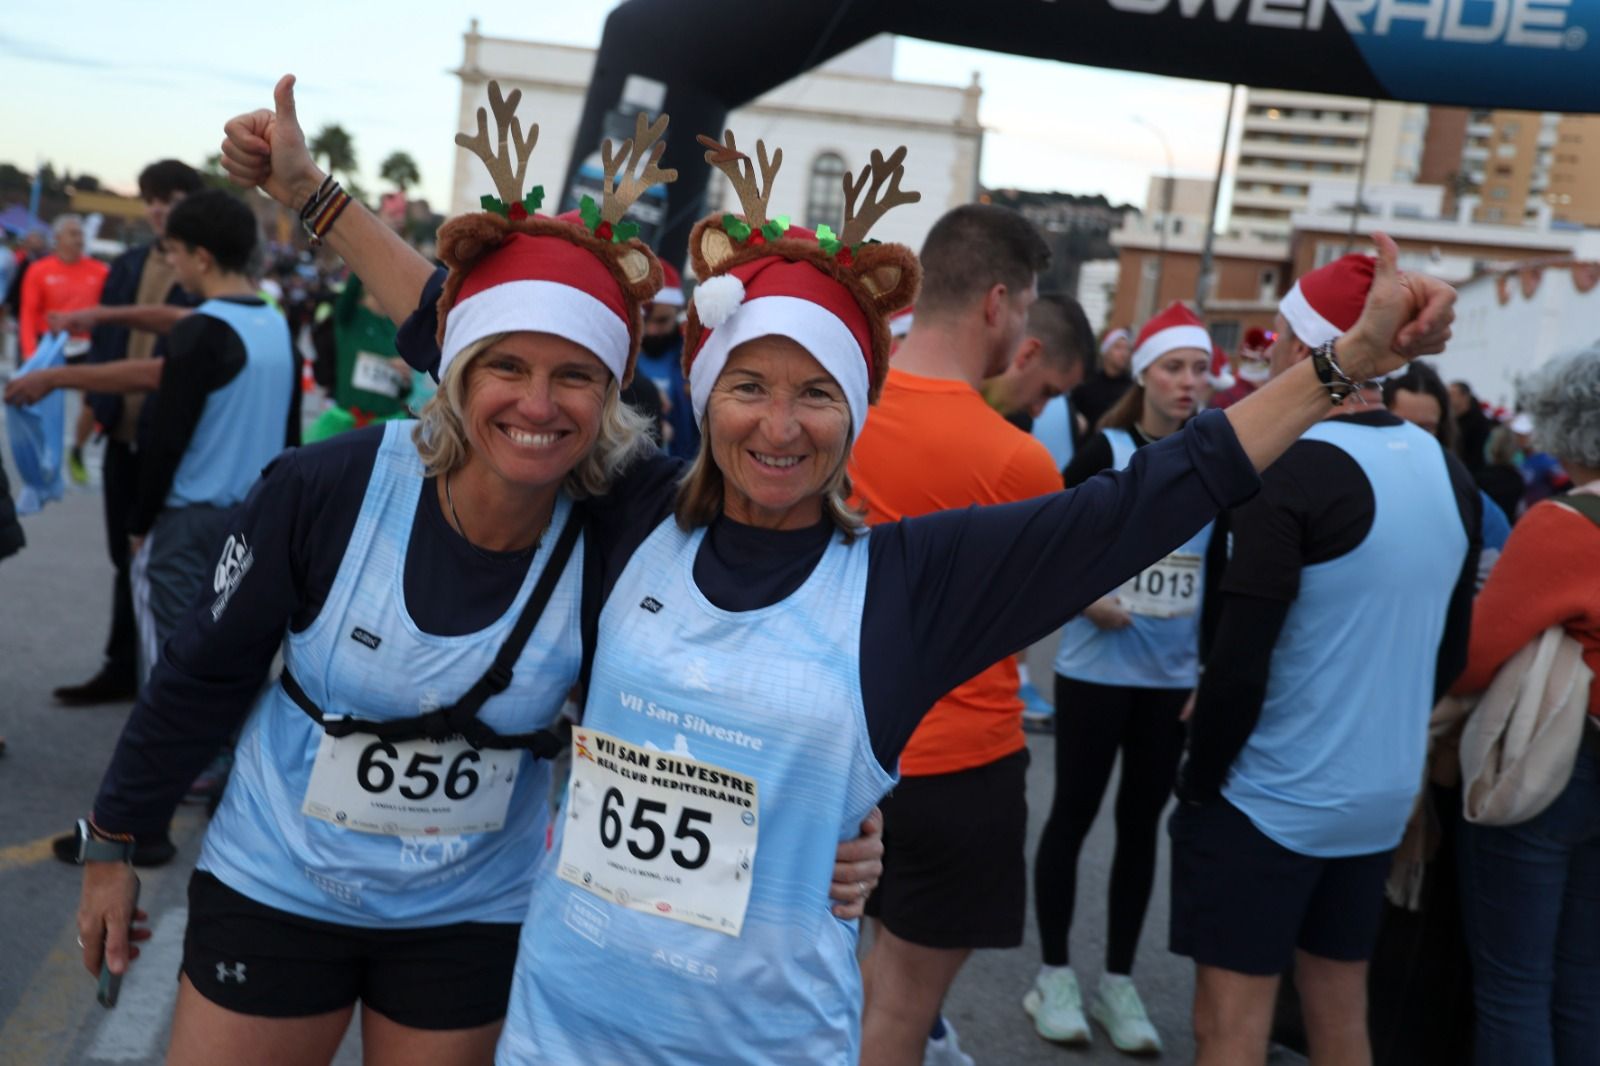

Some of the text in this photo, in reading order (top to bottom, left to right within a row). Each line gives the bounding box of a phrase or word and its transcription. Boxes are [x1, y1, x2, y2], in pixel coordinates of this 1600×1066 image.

[619, 691, 763, 751] VII San Silvestre
[357, 742, 481, 800] 656
[595, 737, 755, 795] VII SAN SILVESTRE
[597, 757, 618, 773] REAL
[621, 767, 647, 784] CLUB
[600, 786, 713, 870] 655
